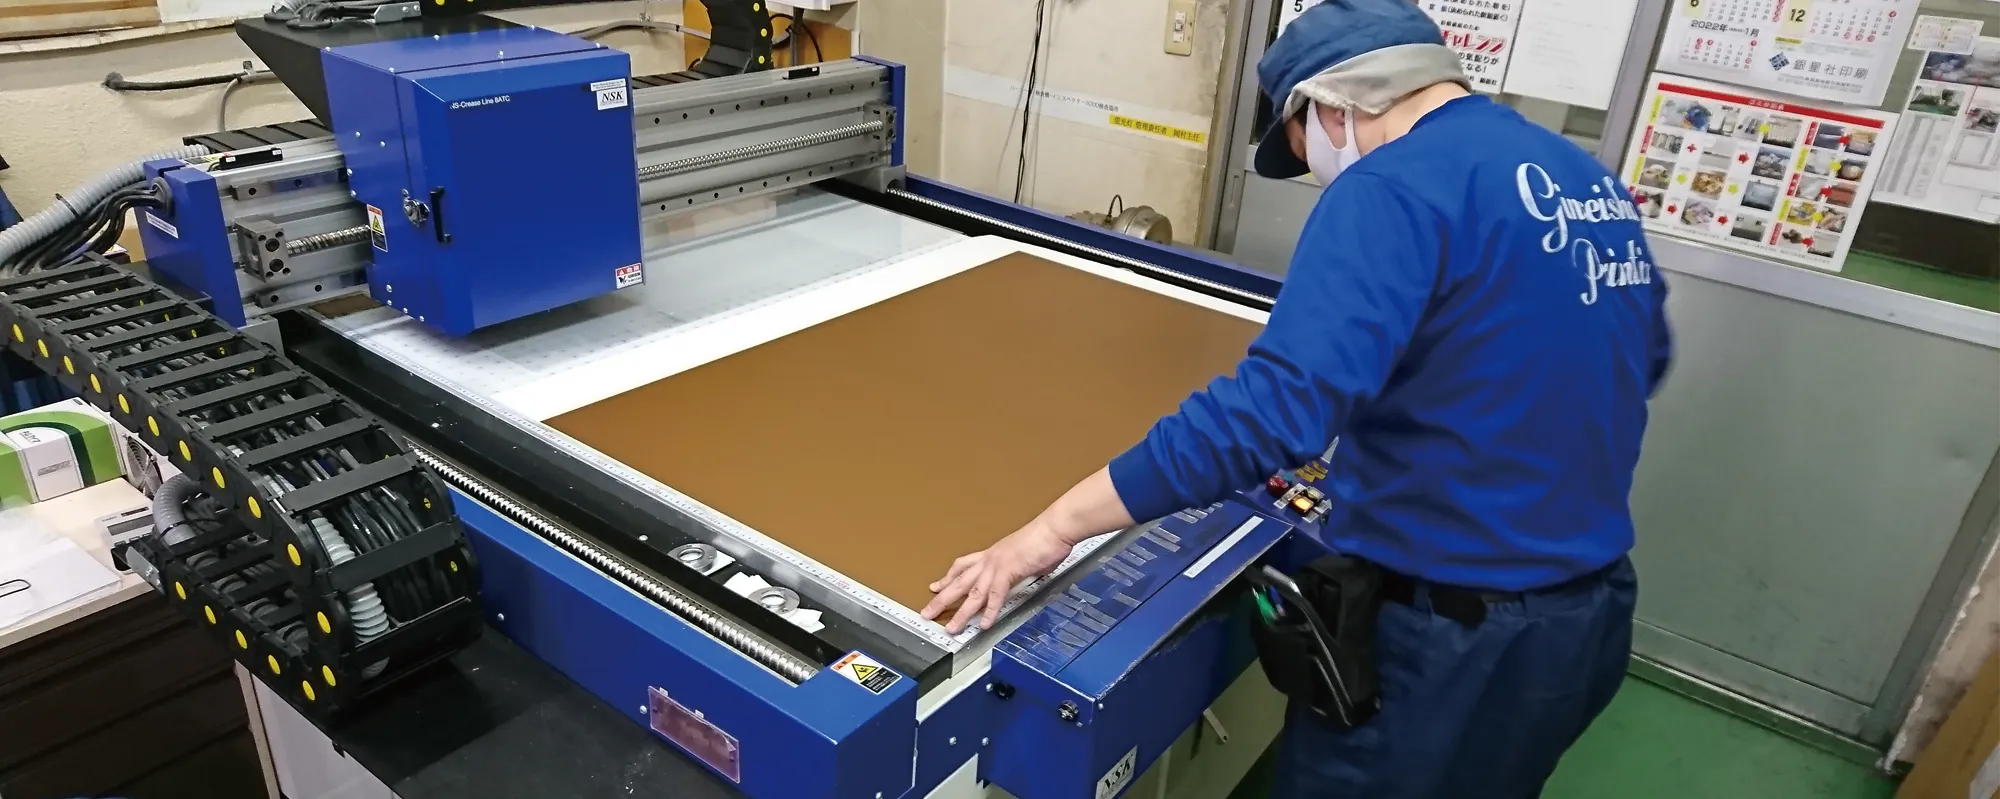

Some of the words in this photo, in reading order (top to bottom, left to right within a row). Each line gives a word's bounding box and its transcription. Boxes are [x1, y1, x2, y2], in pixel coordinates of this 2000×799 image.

[1294, 0, 1303, 12] 5
[1790, 8, 1806, 22] 12
[1793, 59, 1869, 80] 銀星社印刷
[602, 91, 623, 102] NSK
